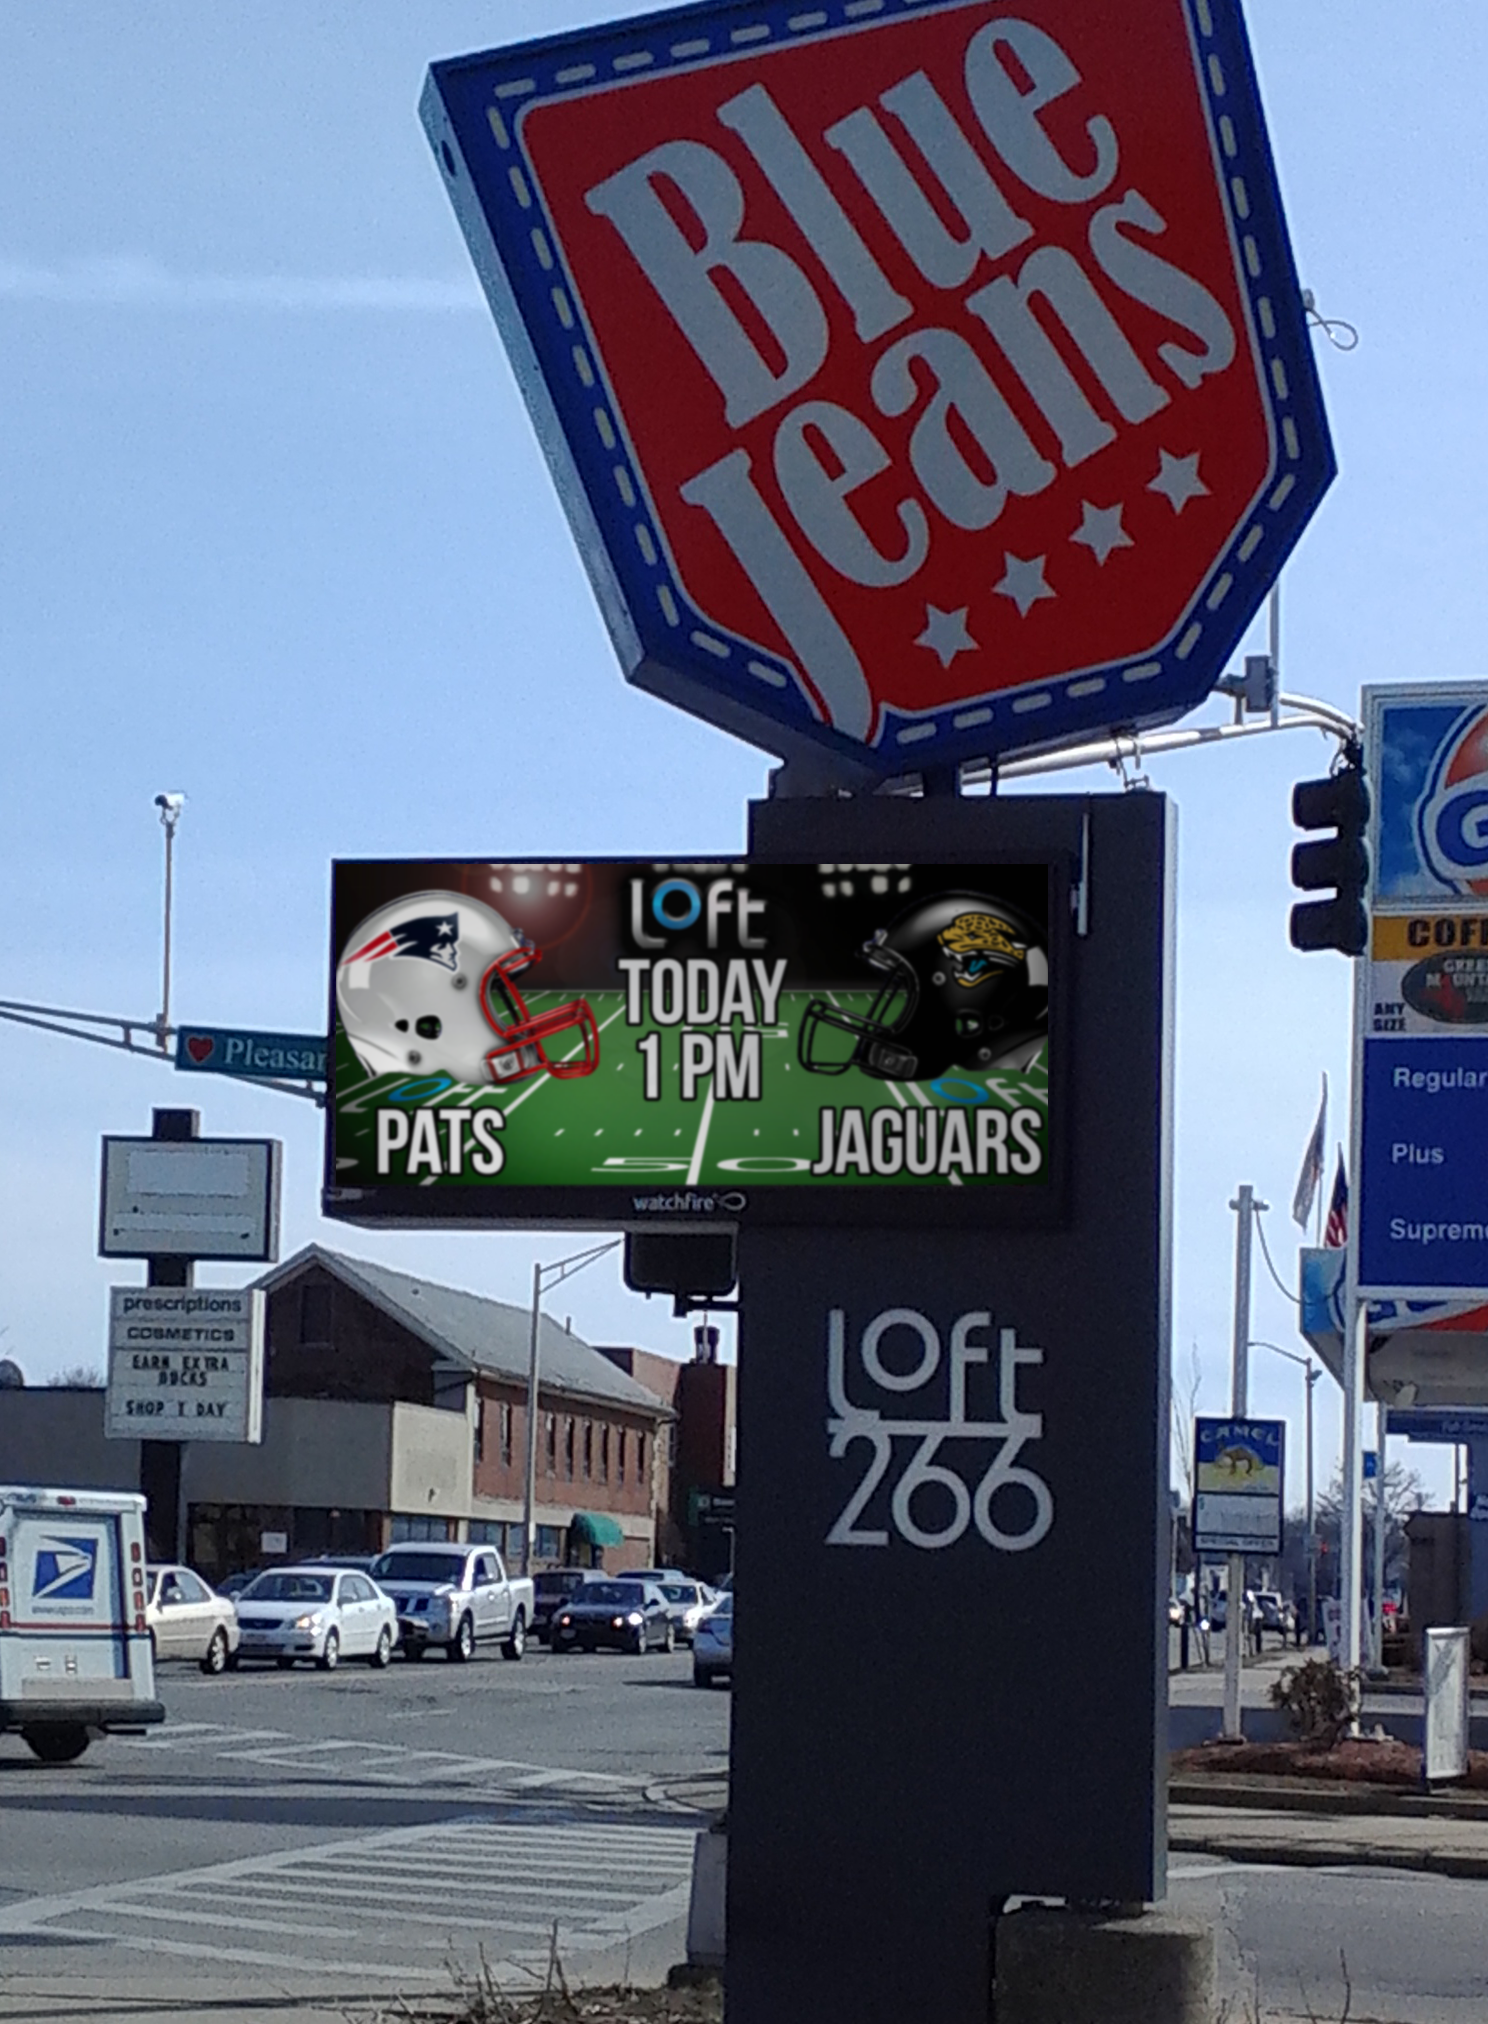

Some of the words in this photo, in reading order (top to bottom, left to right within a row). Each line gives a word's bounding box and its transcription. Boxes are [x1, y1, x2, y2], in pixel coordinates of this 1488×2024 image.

[584, 17, 1119, 430] Blue
[680, 189, 1236, 748] Jeans
[618, 958, 788, 1025] TODAY
[1373, 1002, 1405, 1016] ANY
[638, 1033, 659, 1099] 1
[682, 1033, 760, 1099] PM
[1393, 1067, 1487, 1092] Regular
[377, 1108, 504, 1175] PATS
[812, 1108, 1042, 1175] JAGUARS
[1392, 1143, 1444, 1164] Plus
[632, 1191, 714, 1211] watchfire
[123, 1296, 242, 1315] prescriptions
[127, 1326, 235, 1341] COSMETICS
[182, 1355, 229, 1372] EXTRA
[126, 1400, 164, 1416] SHOP
[197, 1402, 226, 1417] DAY
[1200, 1425, 1279, 1446] CAMEL
[825, 1418, 1053, 1550] 266
